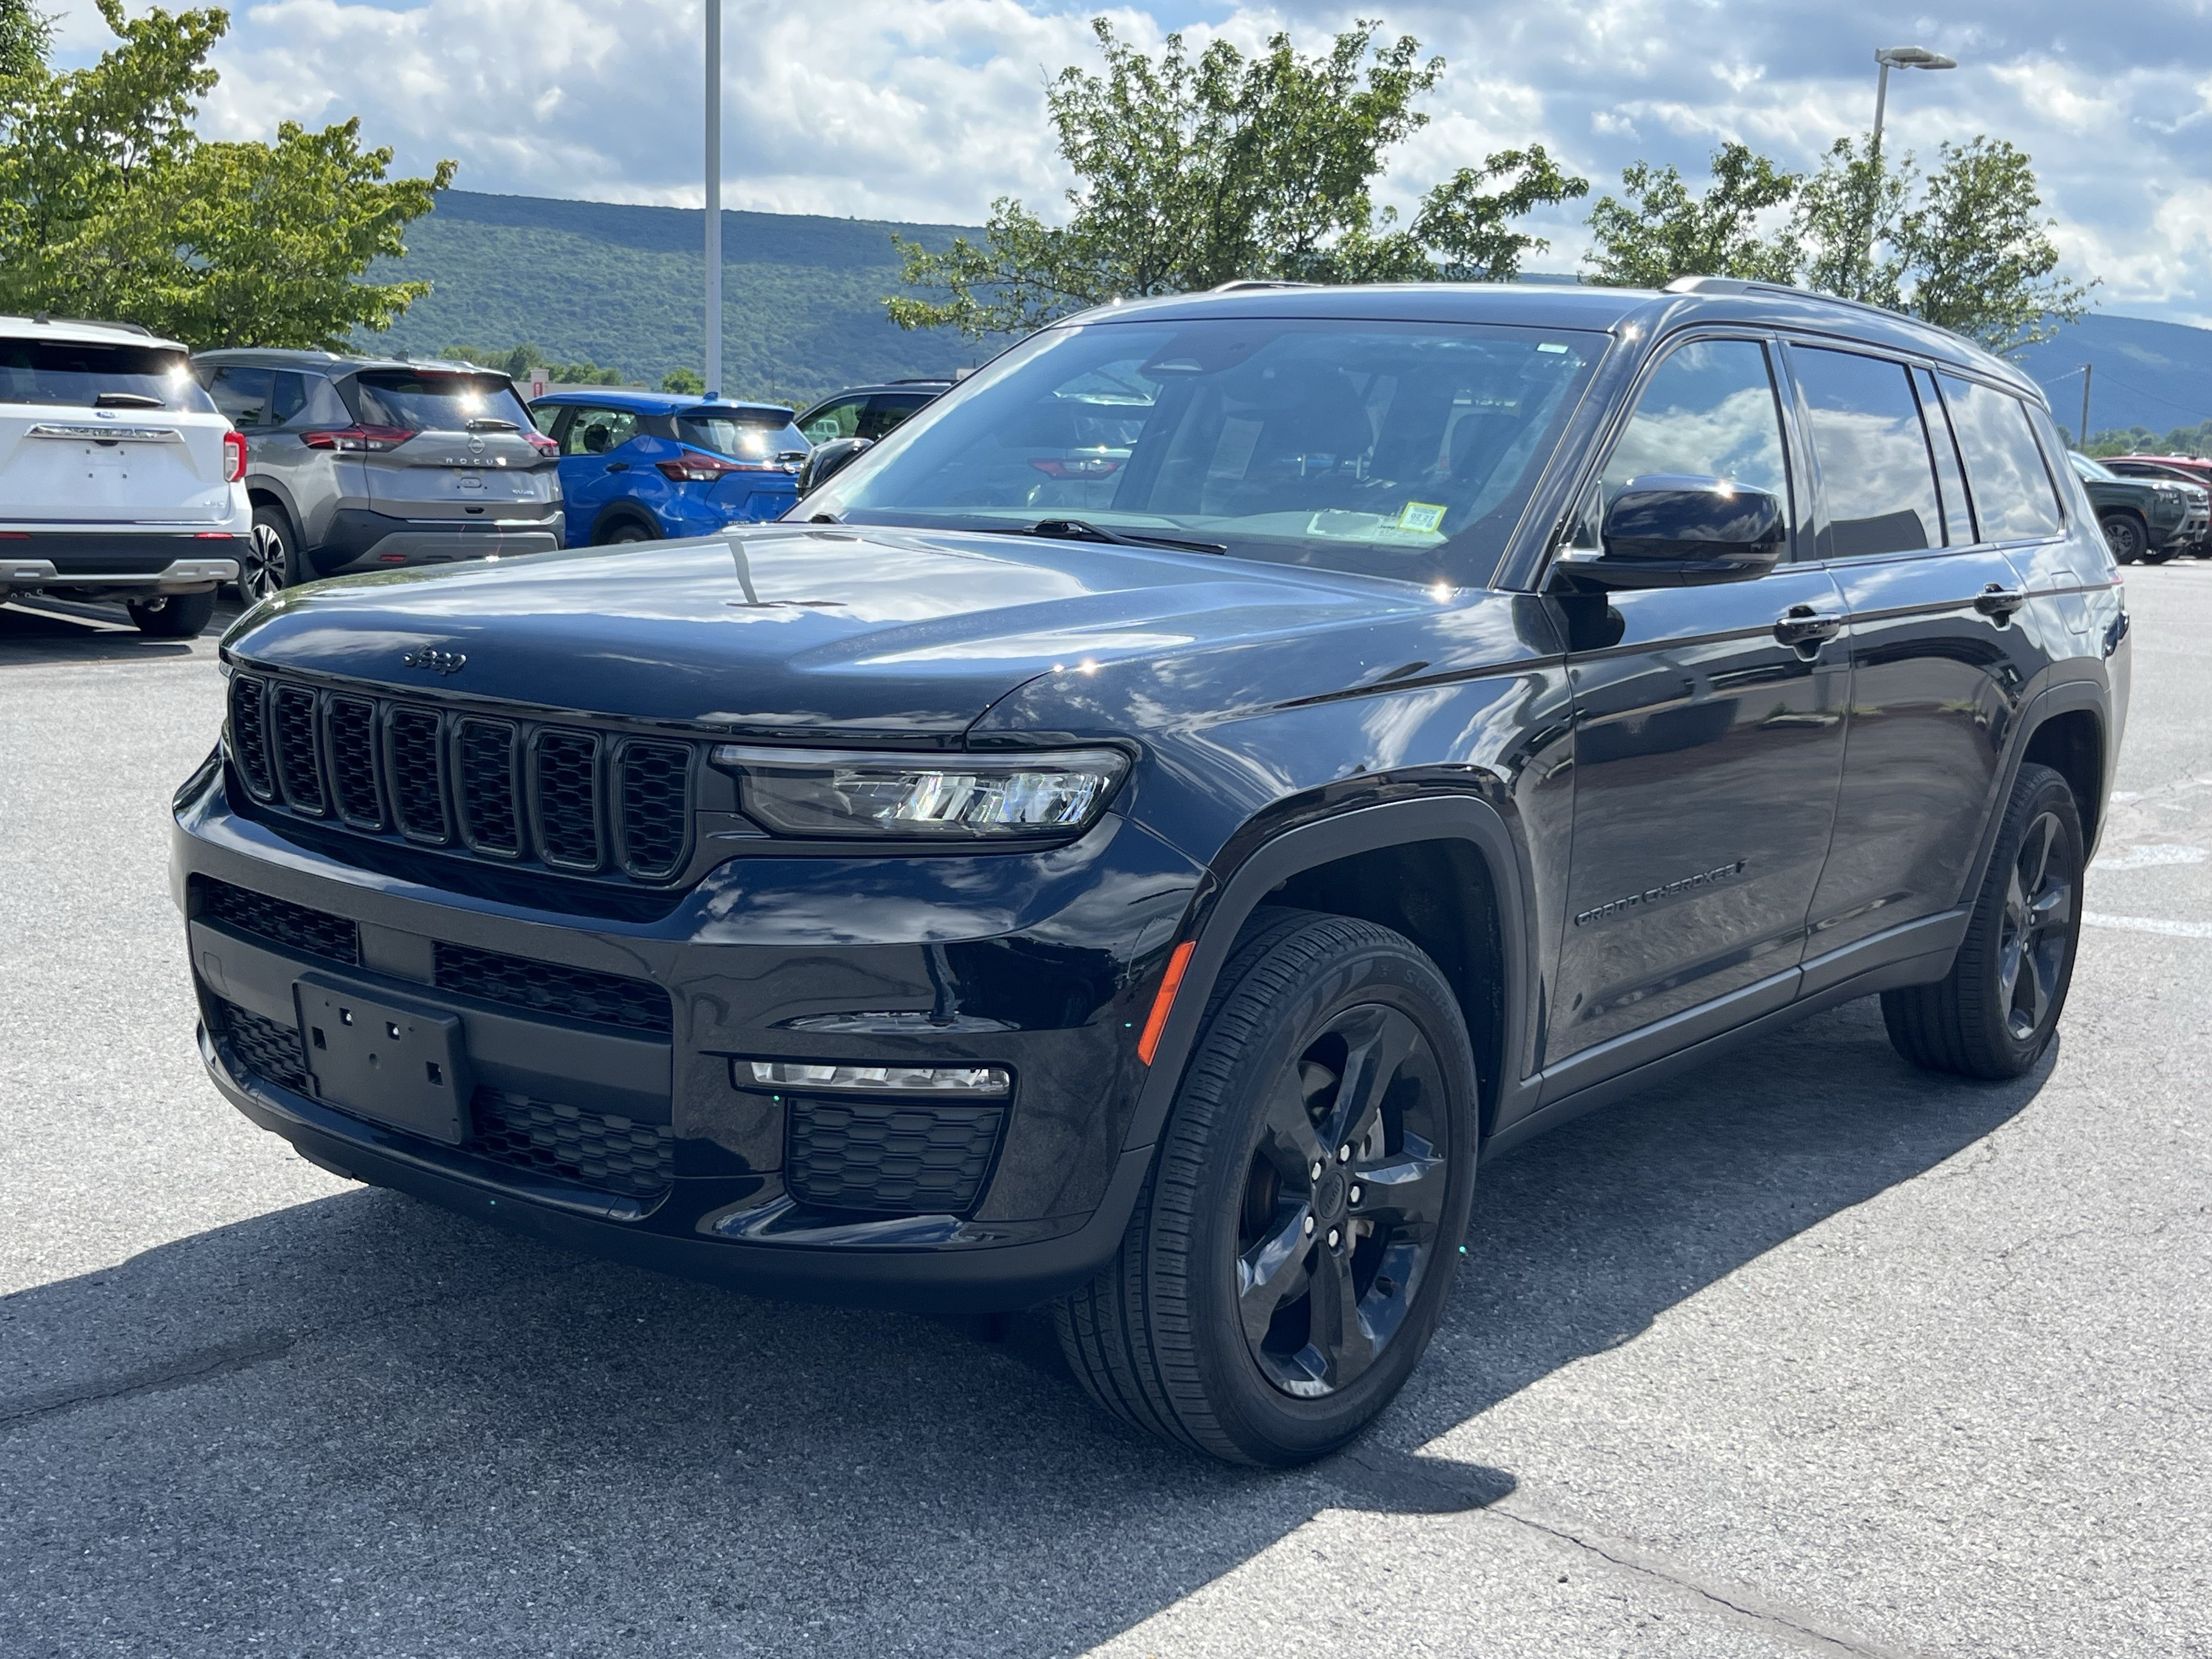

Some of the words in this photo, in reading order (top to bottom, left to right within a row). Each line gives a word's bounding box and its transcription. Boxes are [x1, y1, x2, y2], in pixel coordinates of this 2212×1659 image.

[403, 643, 466, 676] Jeep
[1574, 894, 1640, 927] GRAND
[1642, 863, 1735, 904] CHEROKEE
